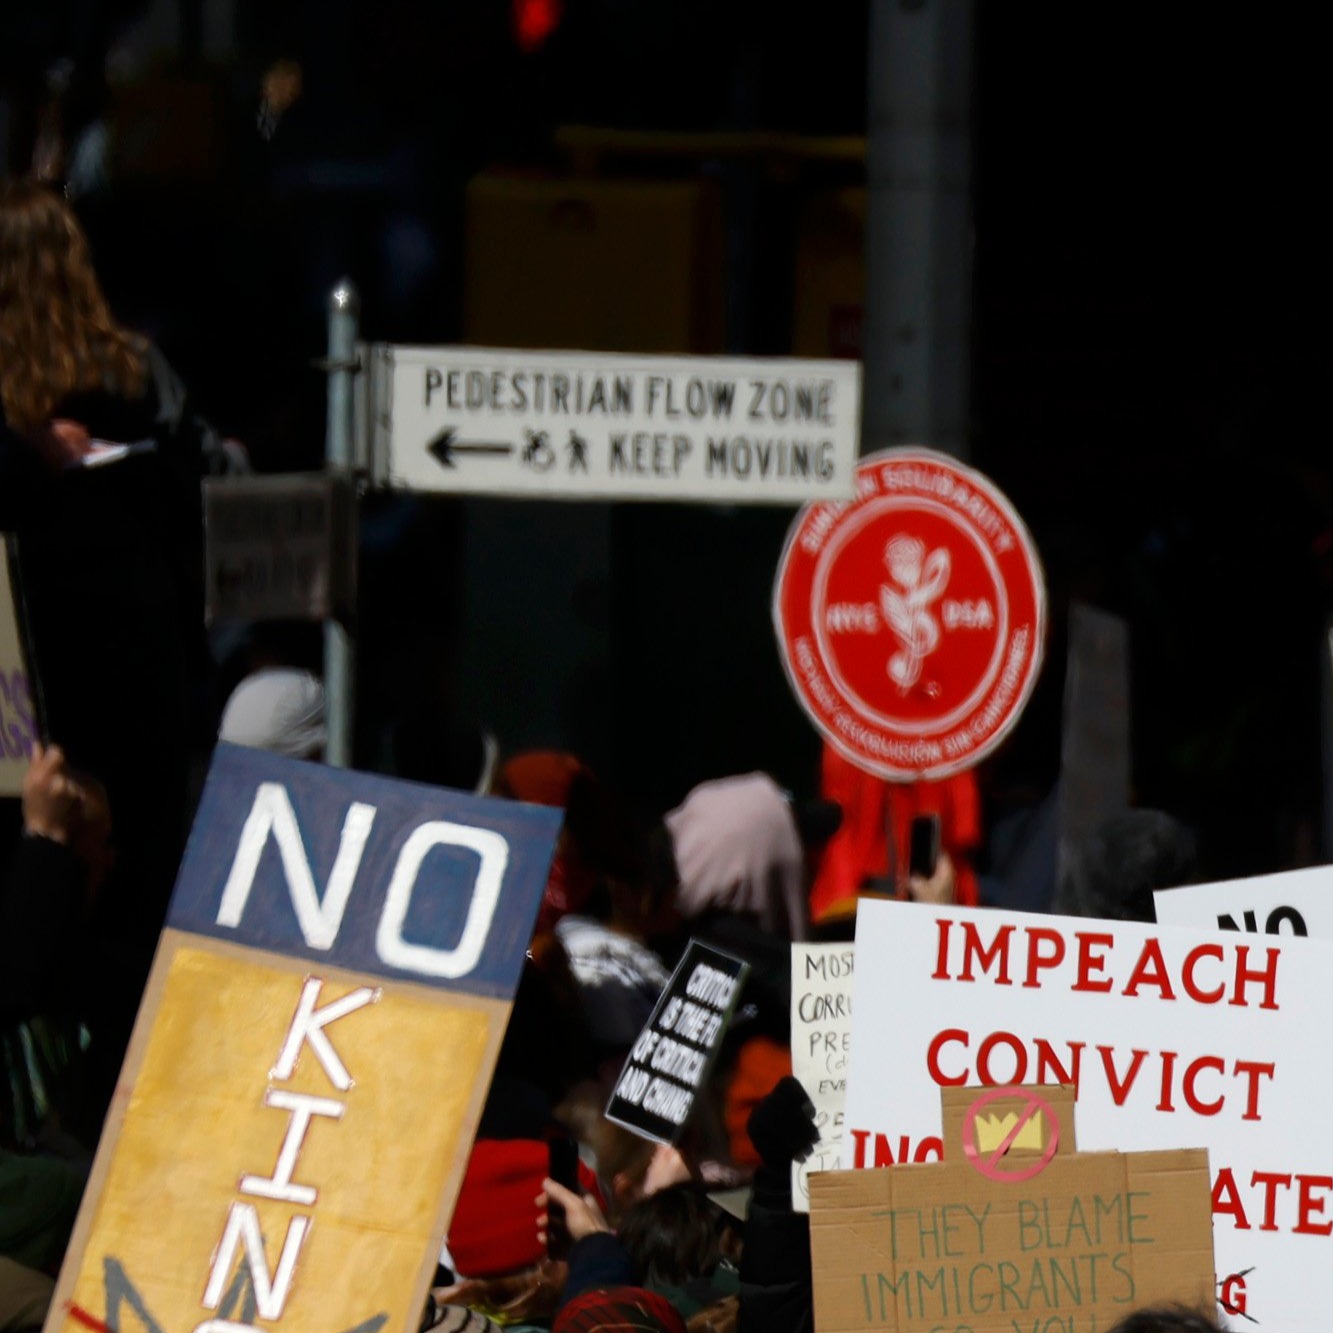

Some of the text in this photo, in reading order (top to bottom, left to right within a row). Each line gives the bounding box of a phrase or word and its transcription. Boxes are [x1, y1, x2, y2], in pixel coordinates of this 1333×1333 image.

[424, 368, 836, 426] PEDESTRIAN FLOW ZONE
[608, 431, 836, 481] KEEP MOVING
[942, 598, 995, 630] DSA
[216, 781, 510, 979] NO
[930, 916, 1283, 1011] IMPEACH
[926, 1027, 1277, 1122] CONVICT
[870, 1190, 1156, 1262] THEY BLAME
[860, 1250, 1137, 1323] IMMIGRANTS
